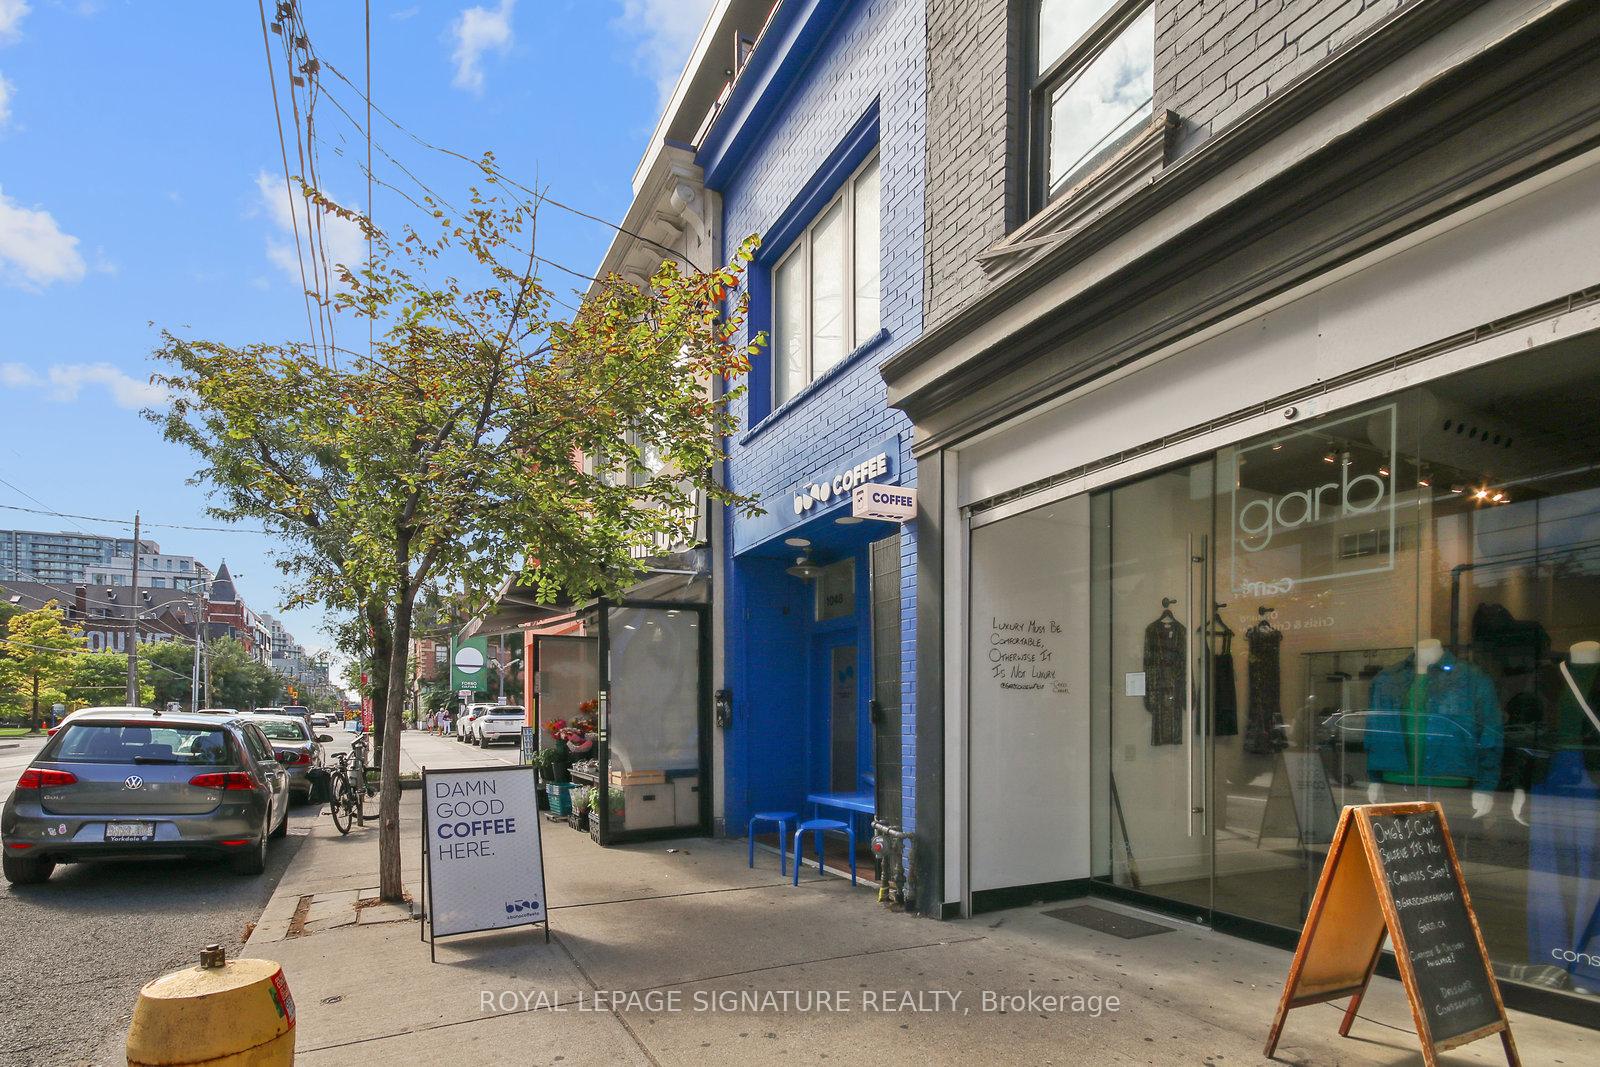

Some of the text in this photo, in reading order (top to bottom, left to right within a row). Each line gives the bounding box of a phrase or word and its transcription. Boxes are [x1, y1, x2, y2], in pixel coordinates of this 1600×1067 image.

[832, 452, 888, 496] COFFEE
[872, 492, 913, 508] COFFEE
[1239, 451, 1385, 552] garb
[435, 780, 496, 799] DAMN
[436, 799, 505, 819] GOOD
[437, 818, 516, 839] COFFEE
[439, 840, 496, 861] HERE.
[1552, 948, 1600, 967] cons
